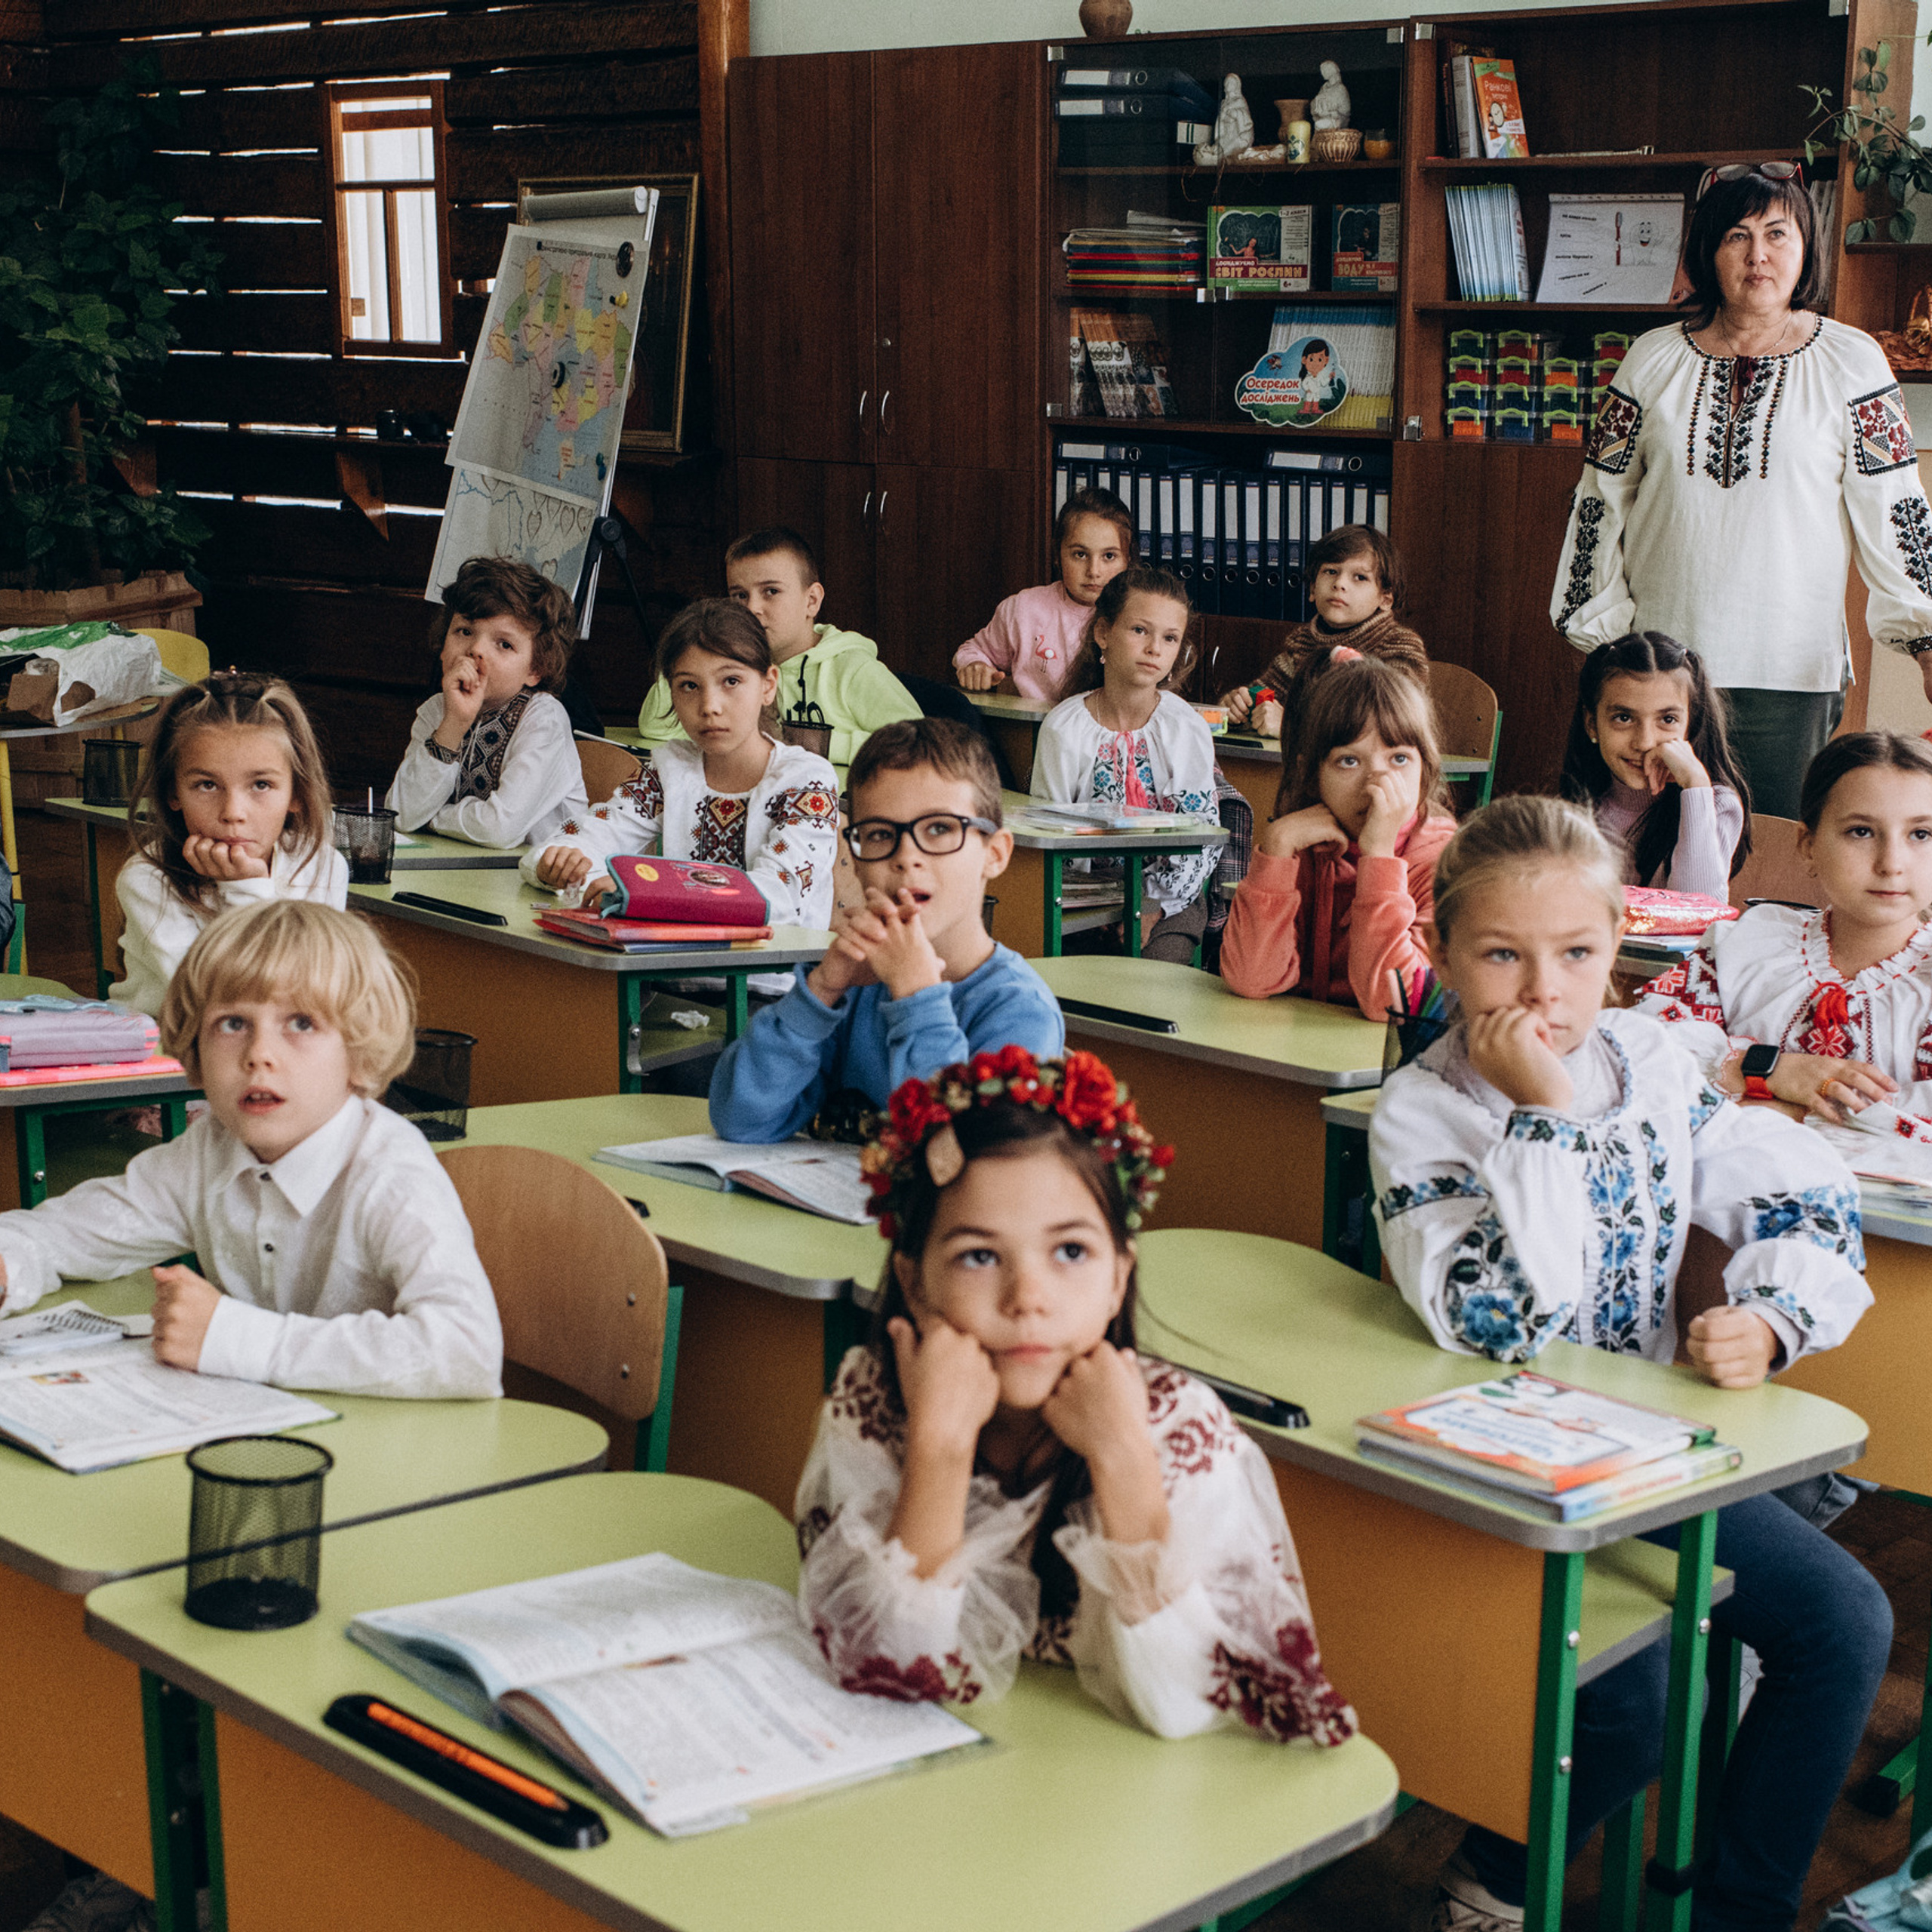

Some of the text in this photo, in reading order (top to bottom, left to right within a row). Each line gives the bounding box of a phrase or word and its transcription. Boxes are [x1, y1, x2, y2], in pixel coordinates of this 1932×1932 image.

[1215, 266, 1303, 278] СВІТ РОСЛИН
[1246, 377, 1300, 389] Осередок
[1241, 392, 1300, 403] досліджень
